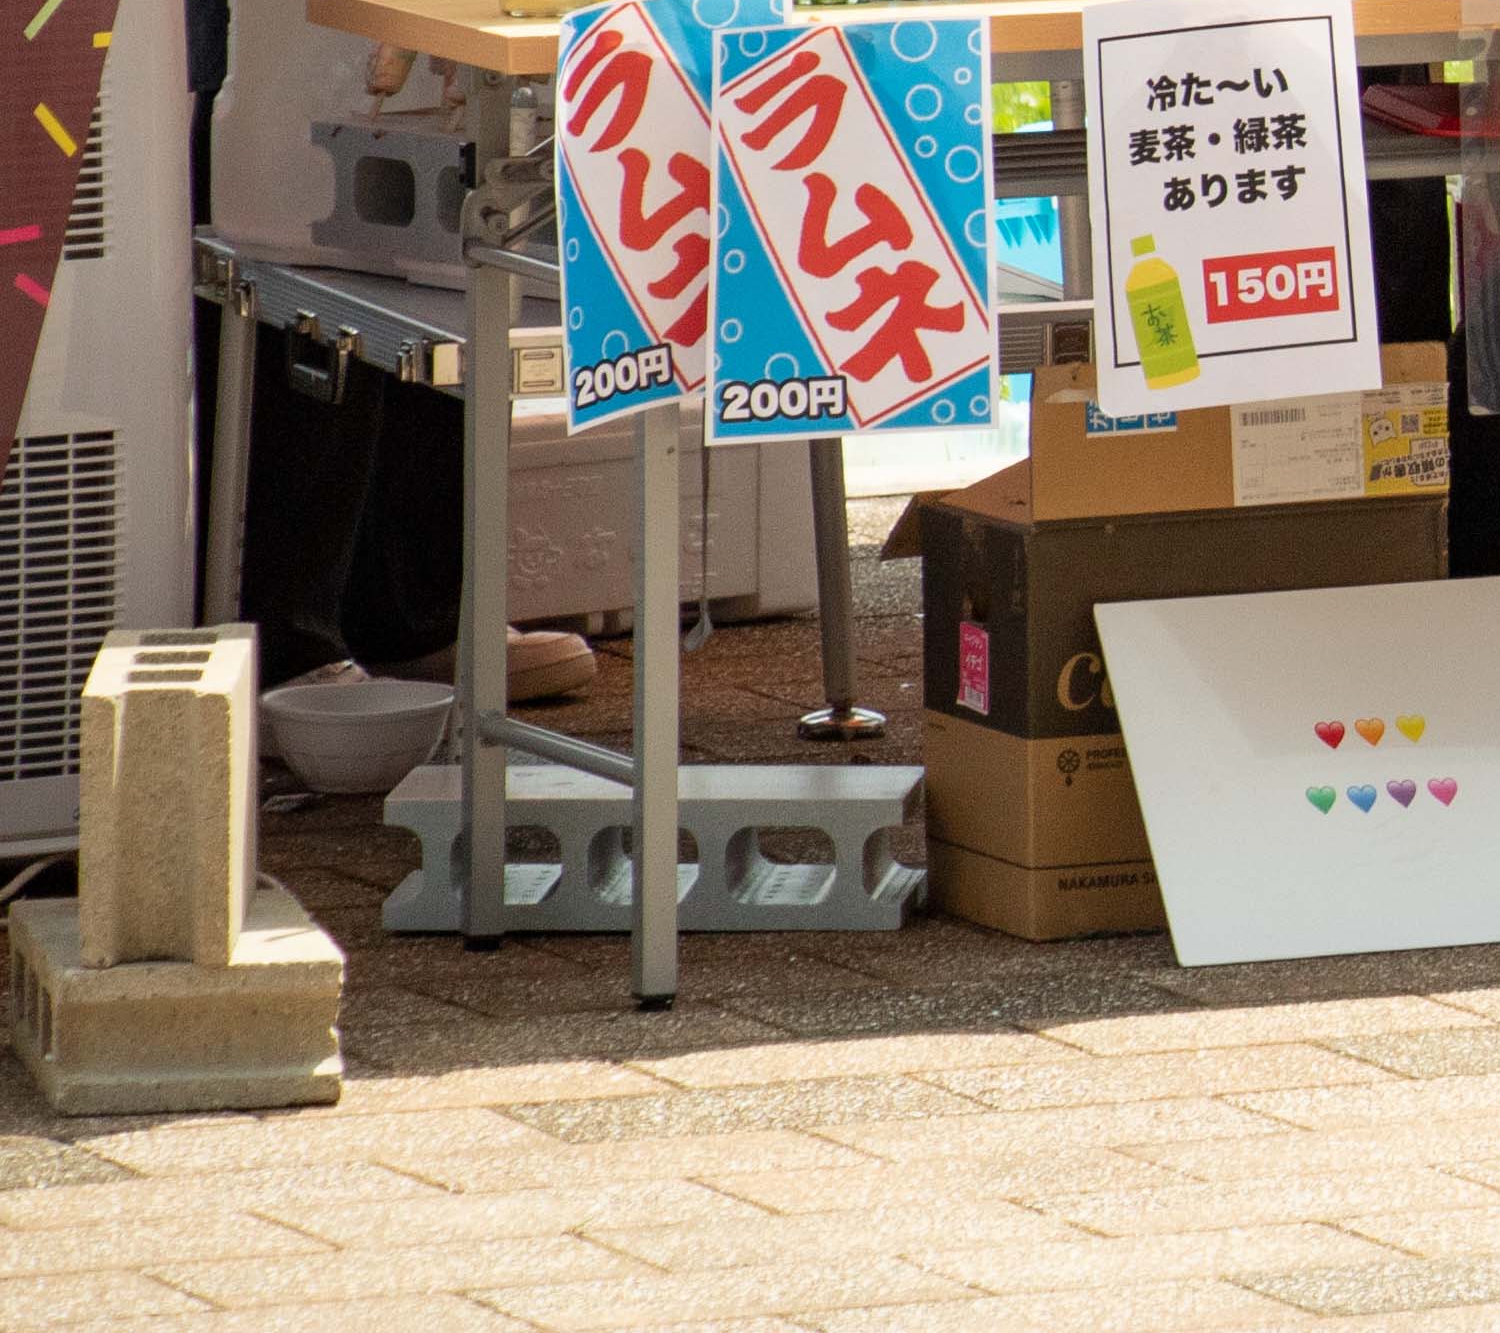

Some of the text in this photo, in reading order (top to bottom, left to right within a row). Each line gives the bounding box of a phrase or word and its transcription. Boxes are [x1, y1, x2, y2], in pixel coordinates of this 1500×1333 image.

[1127, 116, 1308, 166] 麦茶・緑茶
[1161, 164, 1307, 214] あります
[732, 49, 966, 384] ラムネ
[1207, 257, 1337, 307] 150円
[1141, 297, 1179, 350] お茶
[574, 344, 672, 410] 200円
[721, 374, 847, 421] 200円
